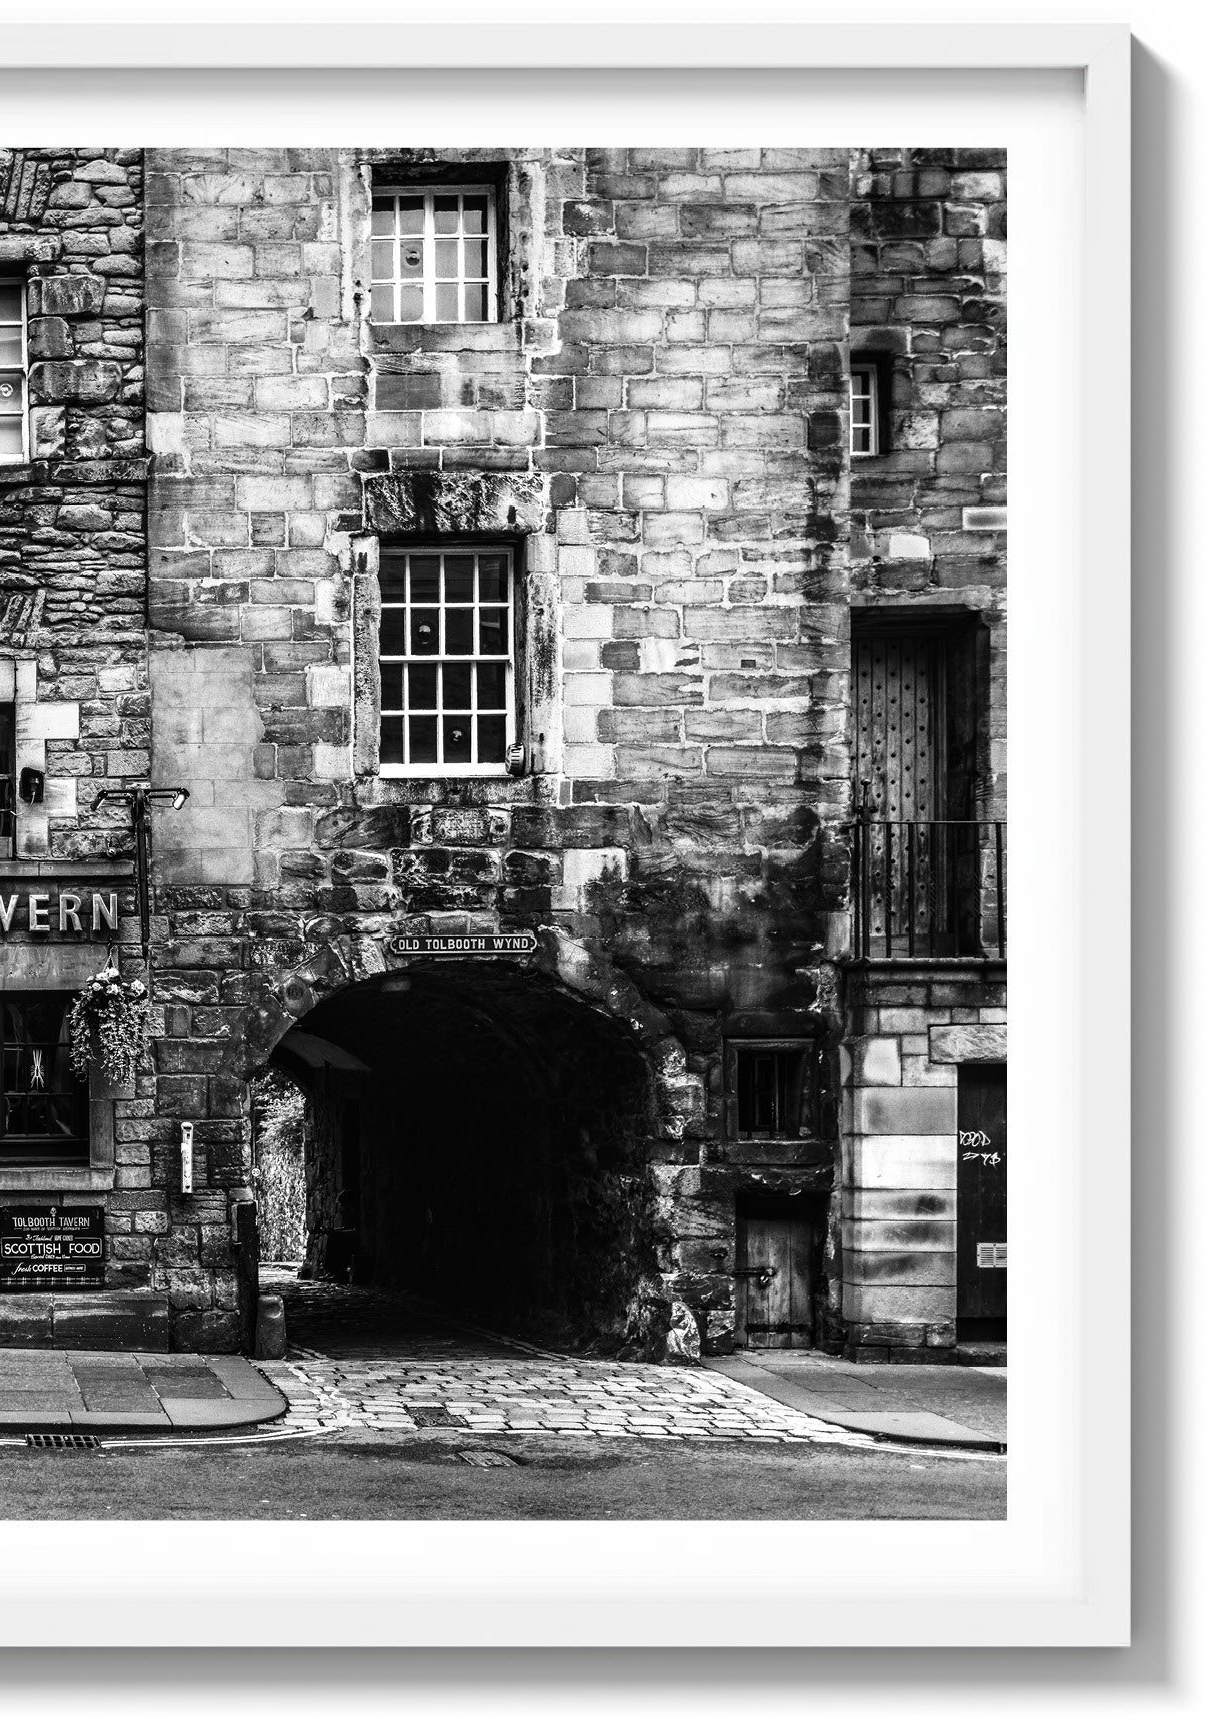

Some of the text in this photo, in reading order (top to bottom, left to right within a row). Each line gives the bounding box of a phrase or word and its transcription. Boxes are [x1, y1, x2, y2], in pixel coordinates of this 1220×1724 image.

[398, 938, 529, 950] OLD TOLBOOTH WYND
[12, 1216, 90, 1228] TOLBOOTH TAVERN
[4, 1243, 100, 1255] SCOTTISH FOOD
[11, 1262, 63, 1275] fresh COFFEE
